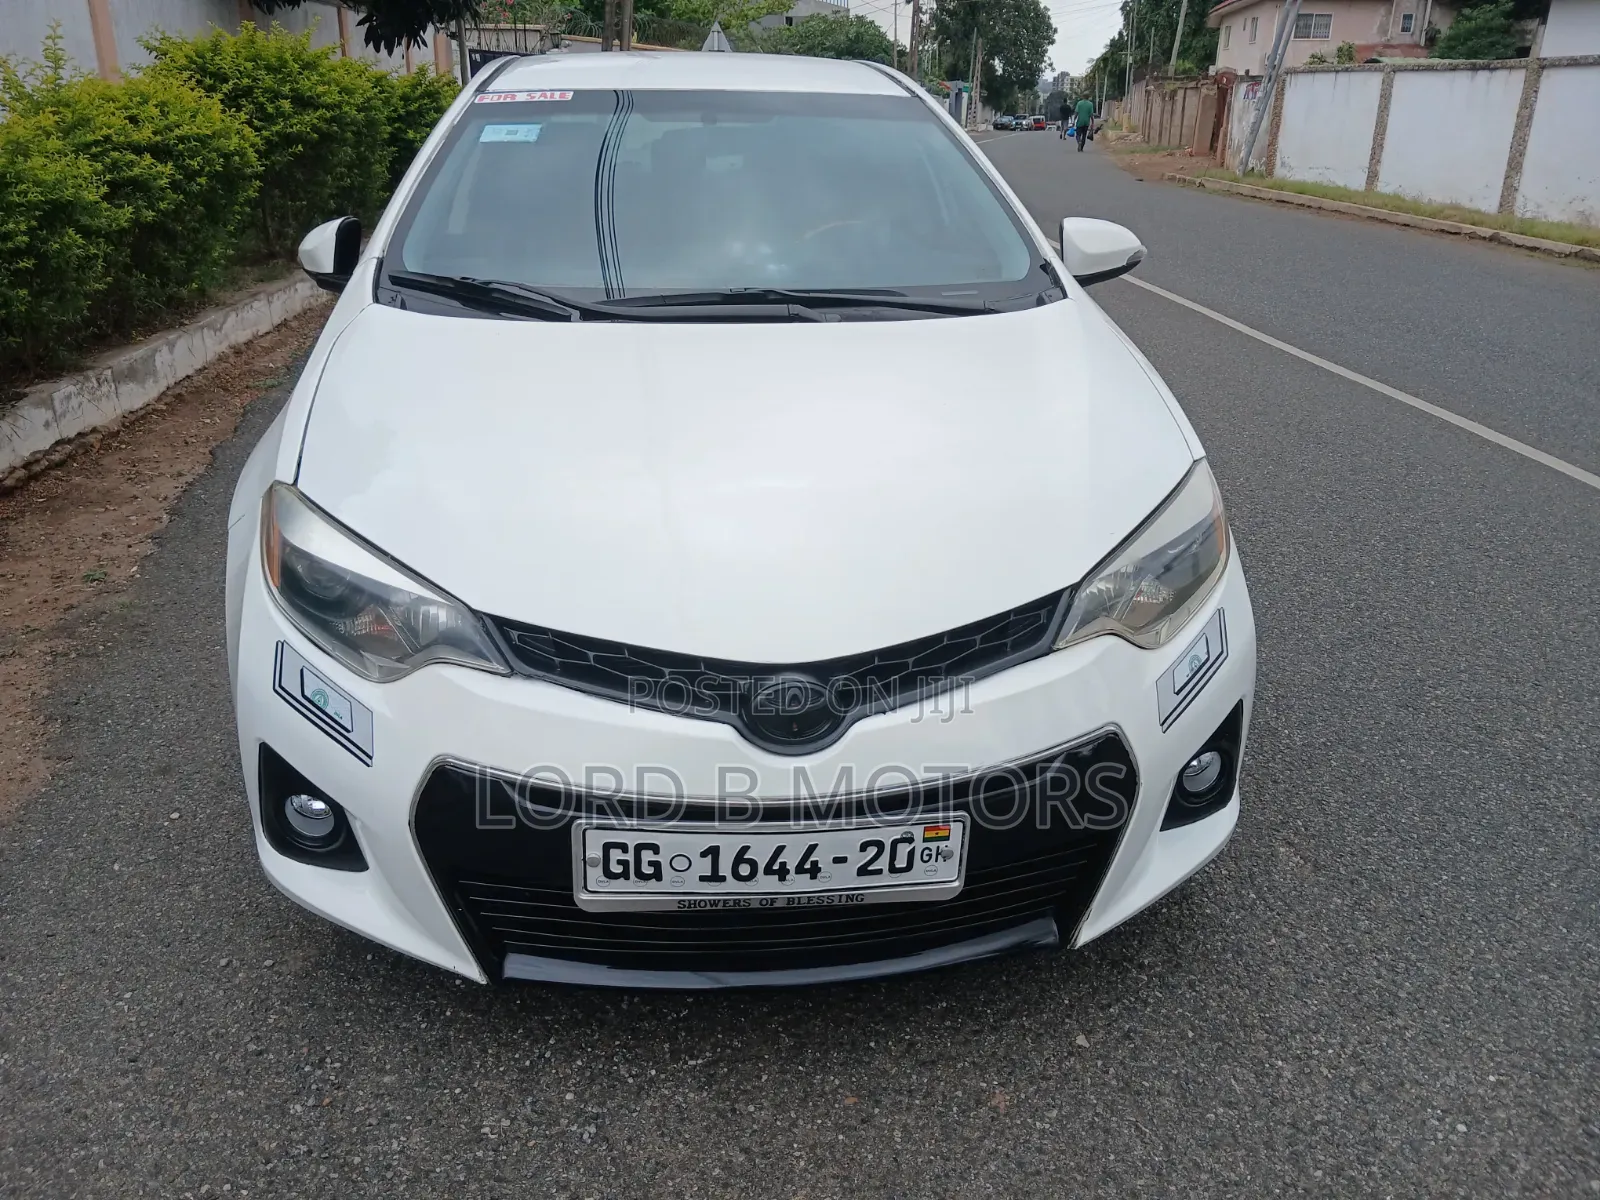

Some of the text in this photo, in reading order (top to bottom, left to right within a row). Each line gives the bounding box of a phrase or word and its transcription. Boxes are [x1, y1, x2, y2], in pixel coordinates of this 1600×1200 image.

[477, 92, 570, 102] FOR SALE
[602, 841, 663, 882] GG
[677, 893, 865, 909] SHOWERS OF BLESSING
